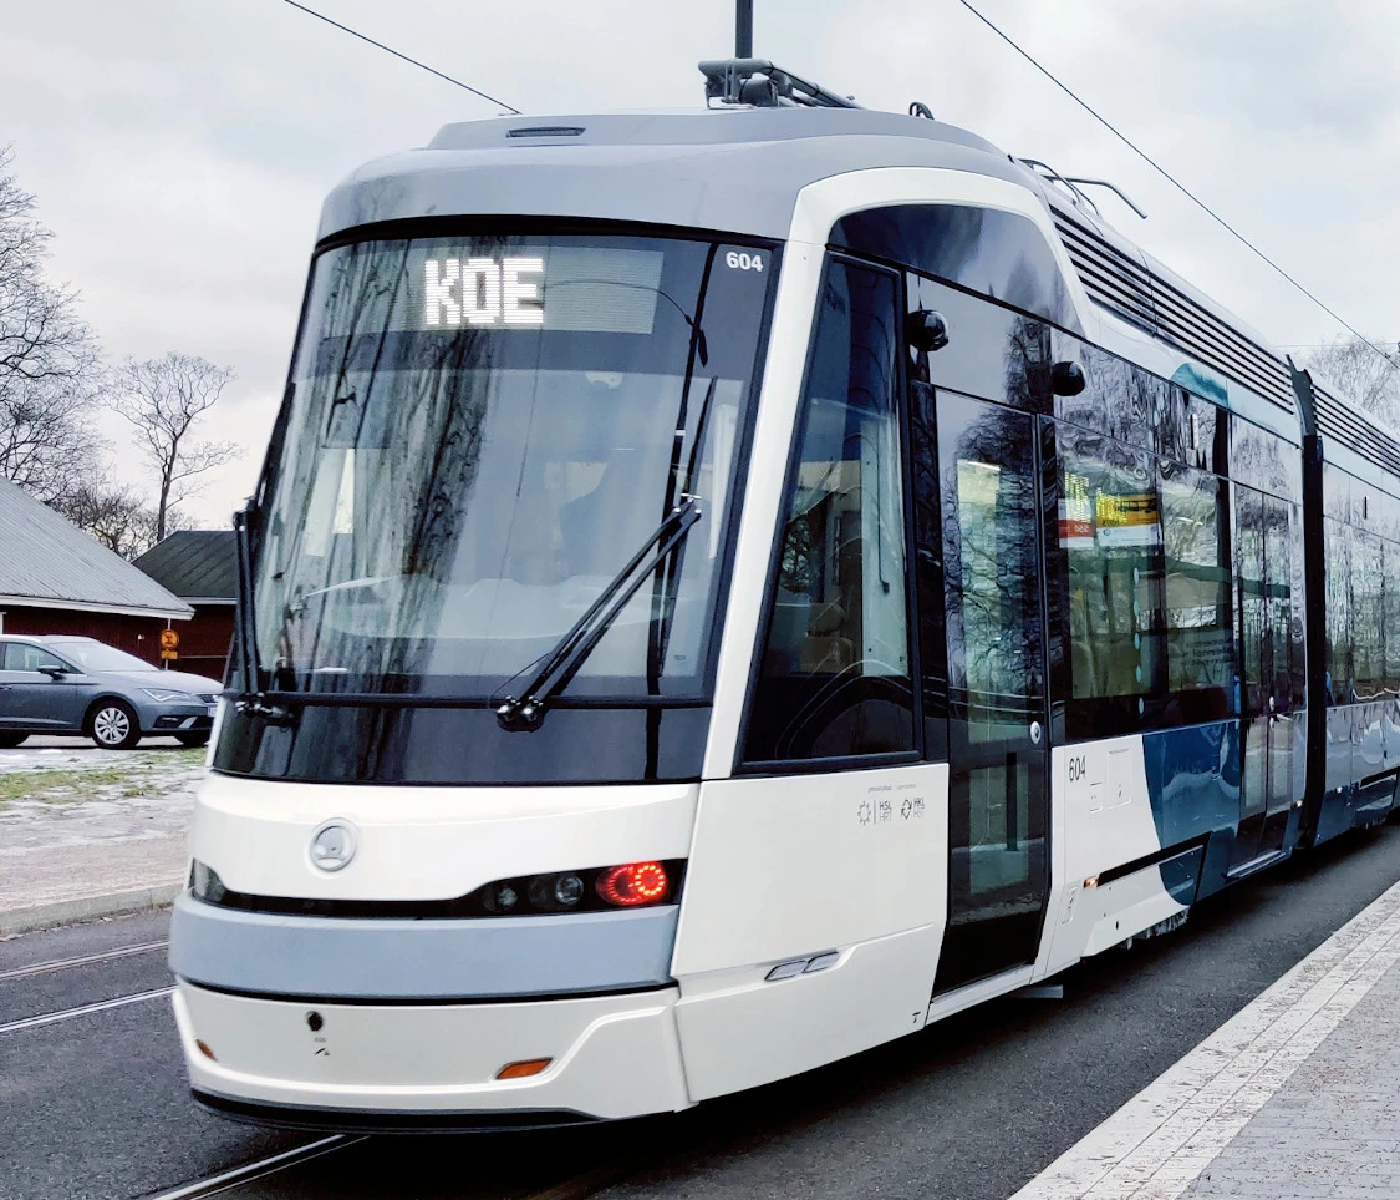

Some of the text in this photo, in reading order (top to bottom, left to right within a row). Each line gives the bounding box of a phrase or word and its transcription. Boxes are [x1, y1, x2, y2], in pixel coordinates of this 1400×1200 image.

[726, 251, 764, 272] 604
[425, 257, 544, 324] KOE
[1069, 755, 1086, 783] 604
